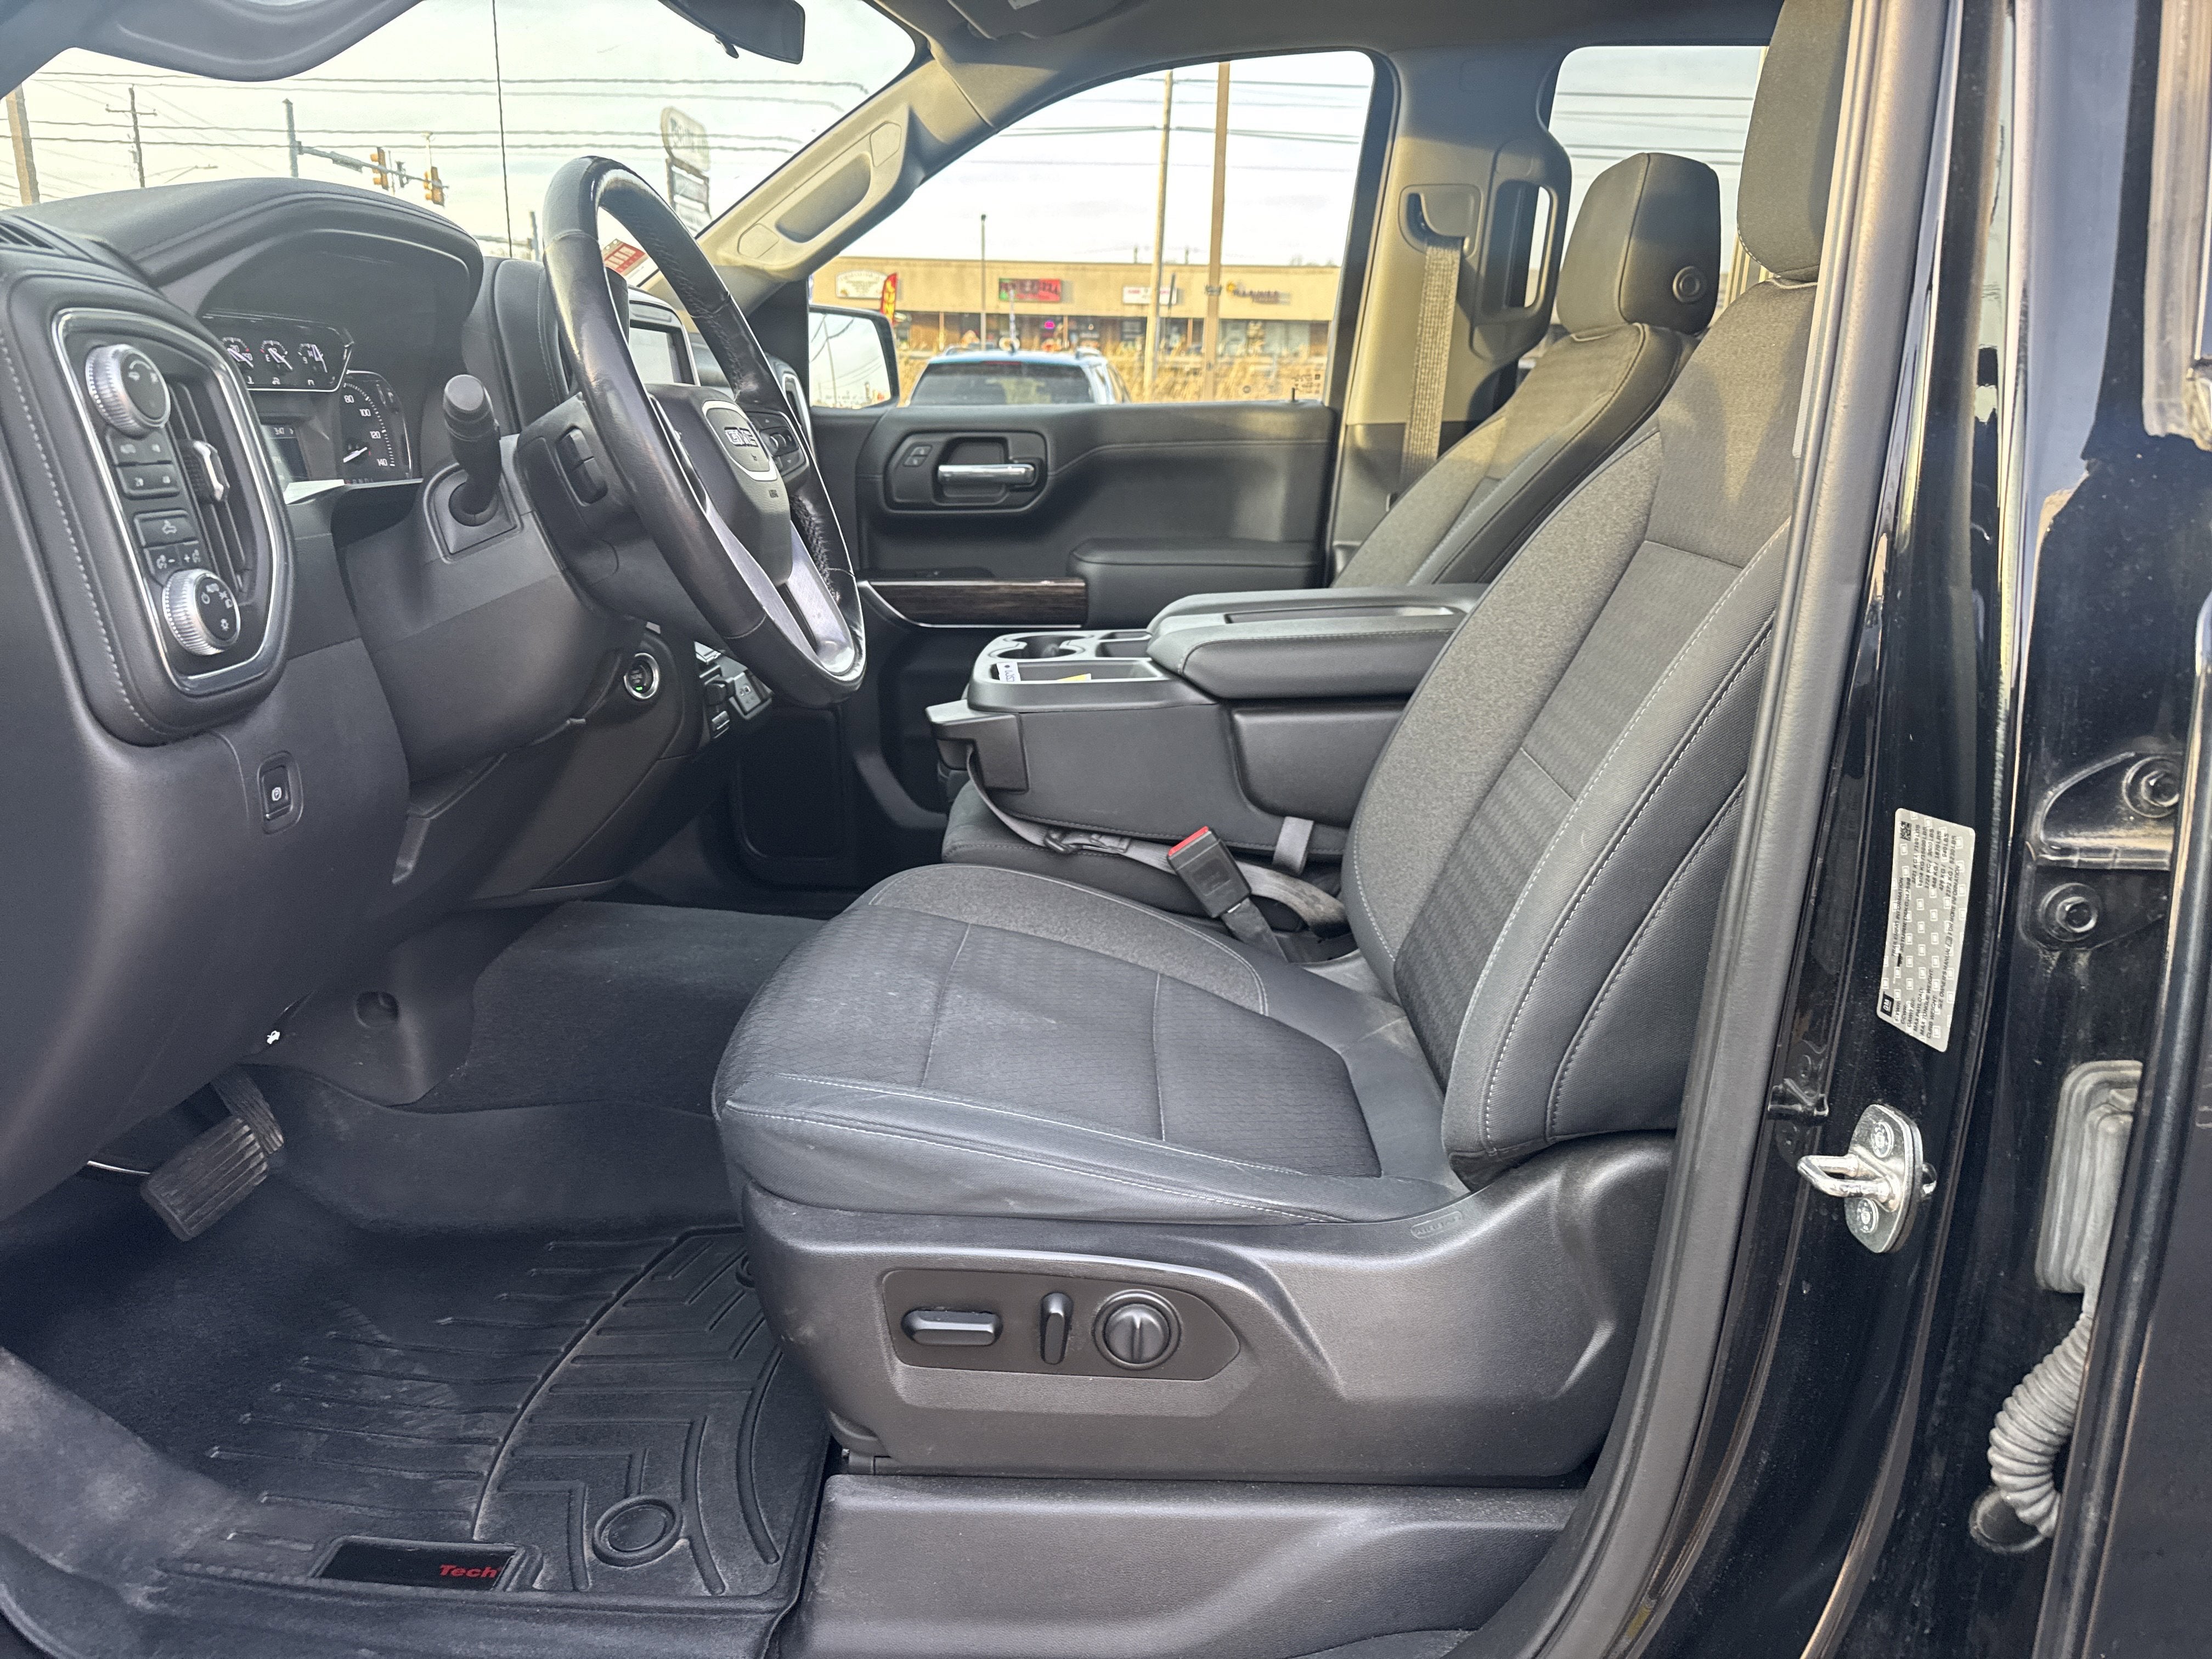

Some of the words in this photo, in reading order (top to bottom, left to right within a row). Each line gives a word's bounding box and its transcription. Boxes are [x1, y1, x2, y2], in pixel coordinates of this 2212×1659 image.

[344, 395, 354, 403] 80
[370, 431, 381, 439] 120
[724, 427, 759, 447] GMC
[1950, 865, 1961, 905] INFORMATION
[1895, 876, 1904, 919] INFORMATION
[1883, 998, 1890, 1012] GM
[439, 1564, 498, 1578] Tech
